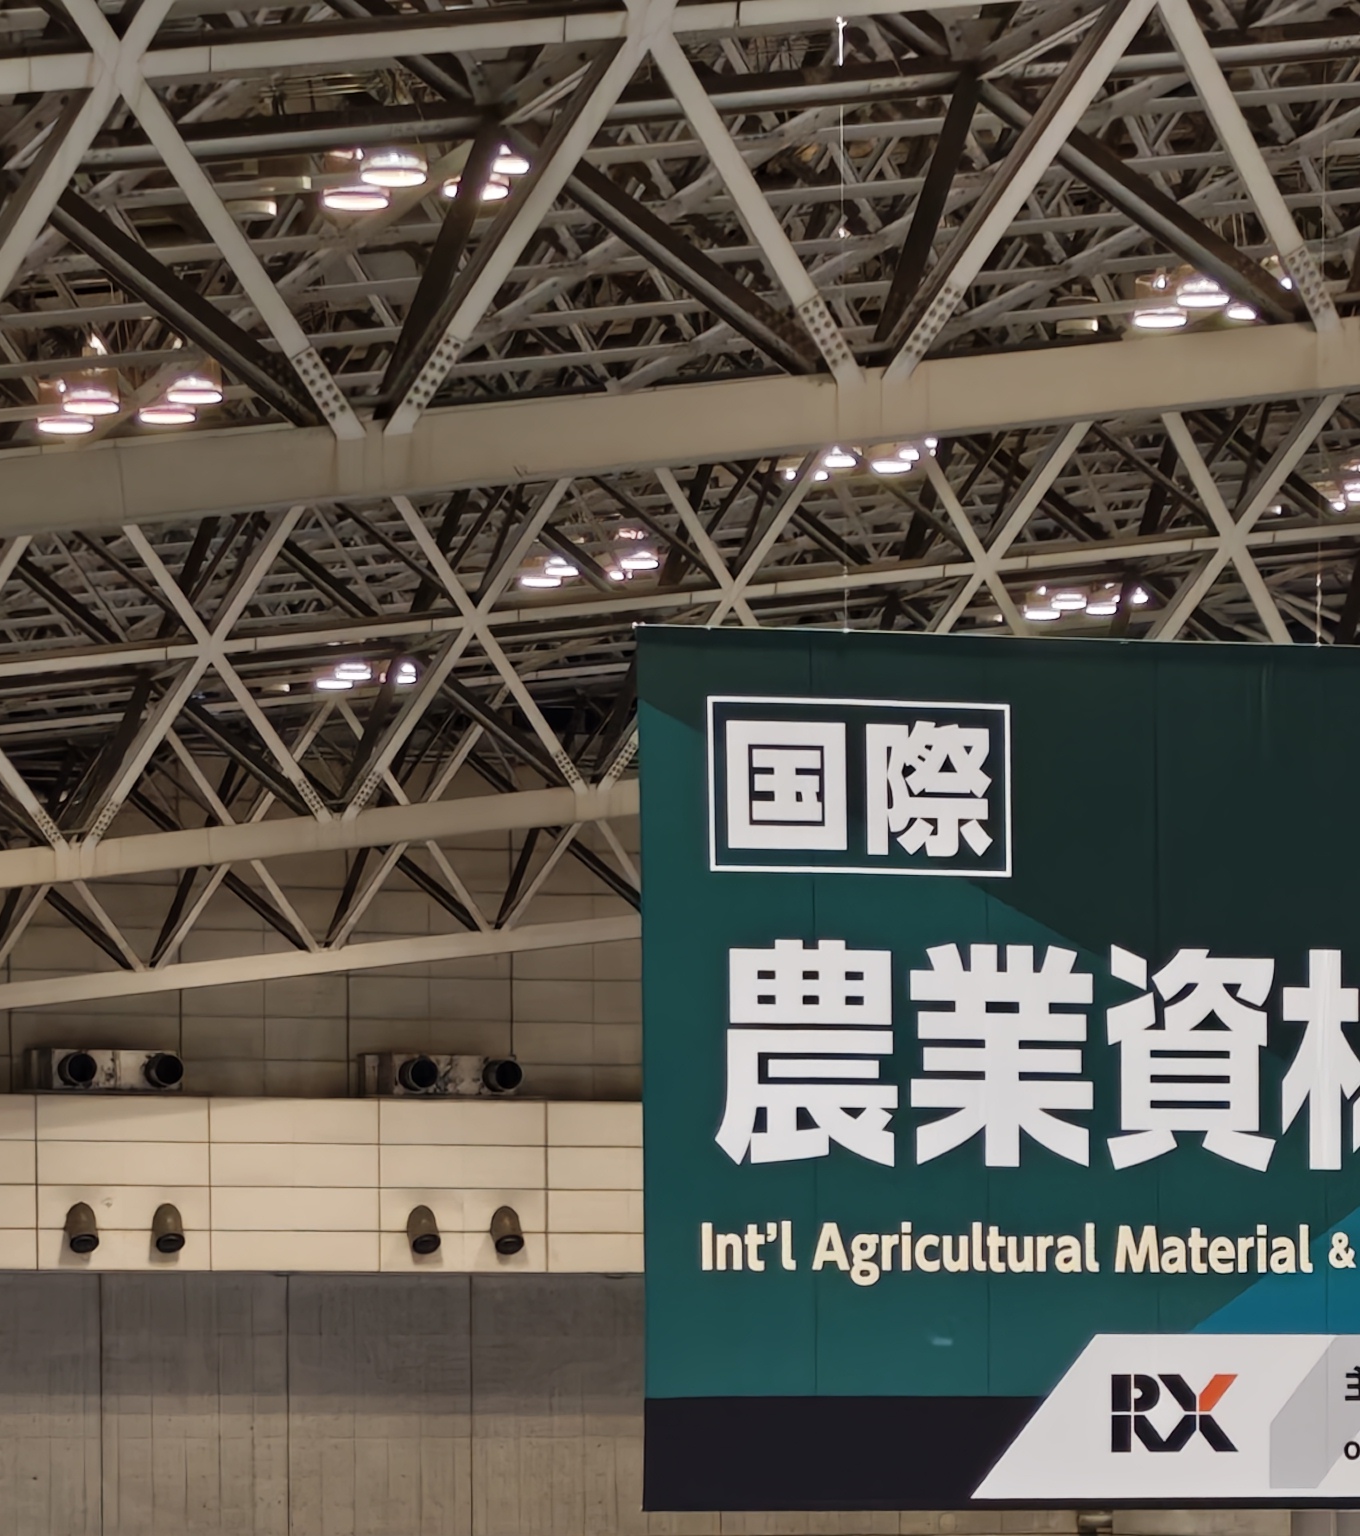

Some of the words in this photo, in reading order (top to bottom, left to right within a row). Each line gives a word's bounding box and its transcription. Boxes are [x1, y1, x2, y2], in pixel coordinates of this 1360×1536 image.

[726, 720, 993, 857] 国際
[701, 1222, 794, 1273] Int'l
[812, 1222, 1098, 1286] Agricultural
[1113, 1225, 1313, 1275] Material
[1327, 1232, 1355, 1271] &
[1111, 1373, 1239, 1453] RX
